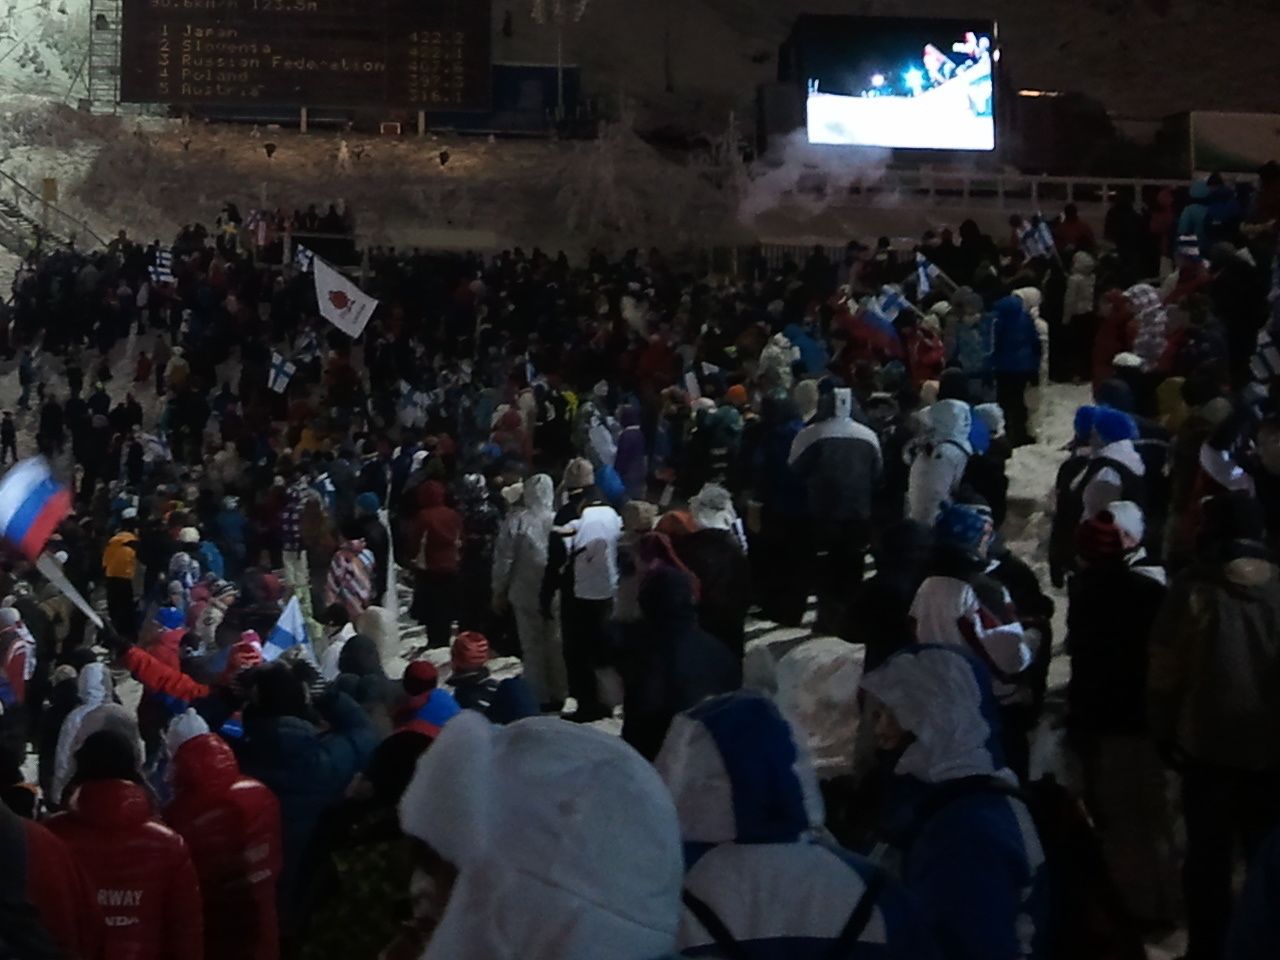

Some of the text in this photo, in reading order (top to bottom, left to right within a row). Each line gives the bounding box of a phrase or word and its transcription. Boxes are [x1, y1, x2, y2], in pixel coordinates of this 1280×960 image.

[184, 24, 239, 39] Japan
[182, 39, 272, 55] Slovenia
[182, 53, 260, 69] Russian
[272, 55, 386, 72] Federation
[182, 68, 249, 83] Poland
[182, 81, 262, 98] Austria
